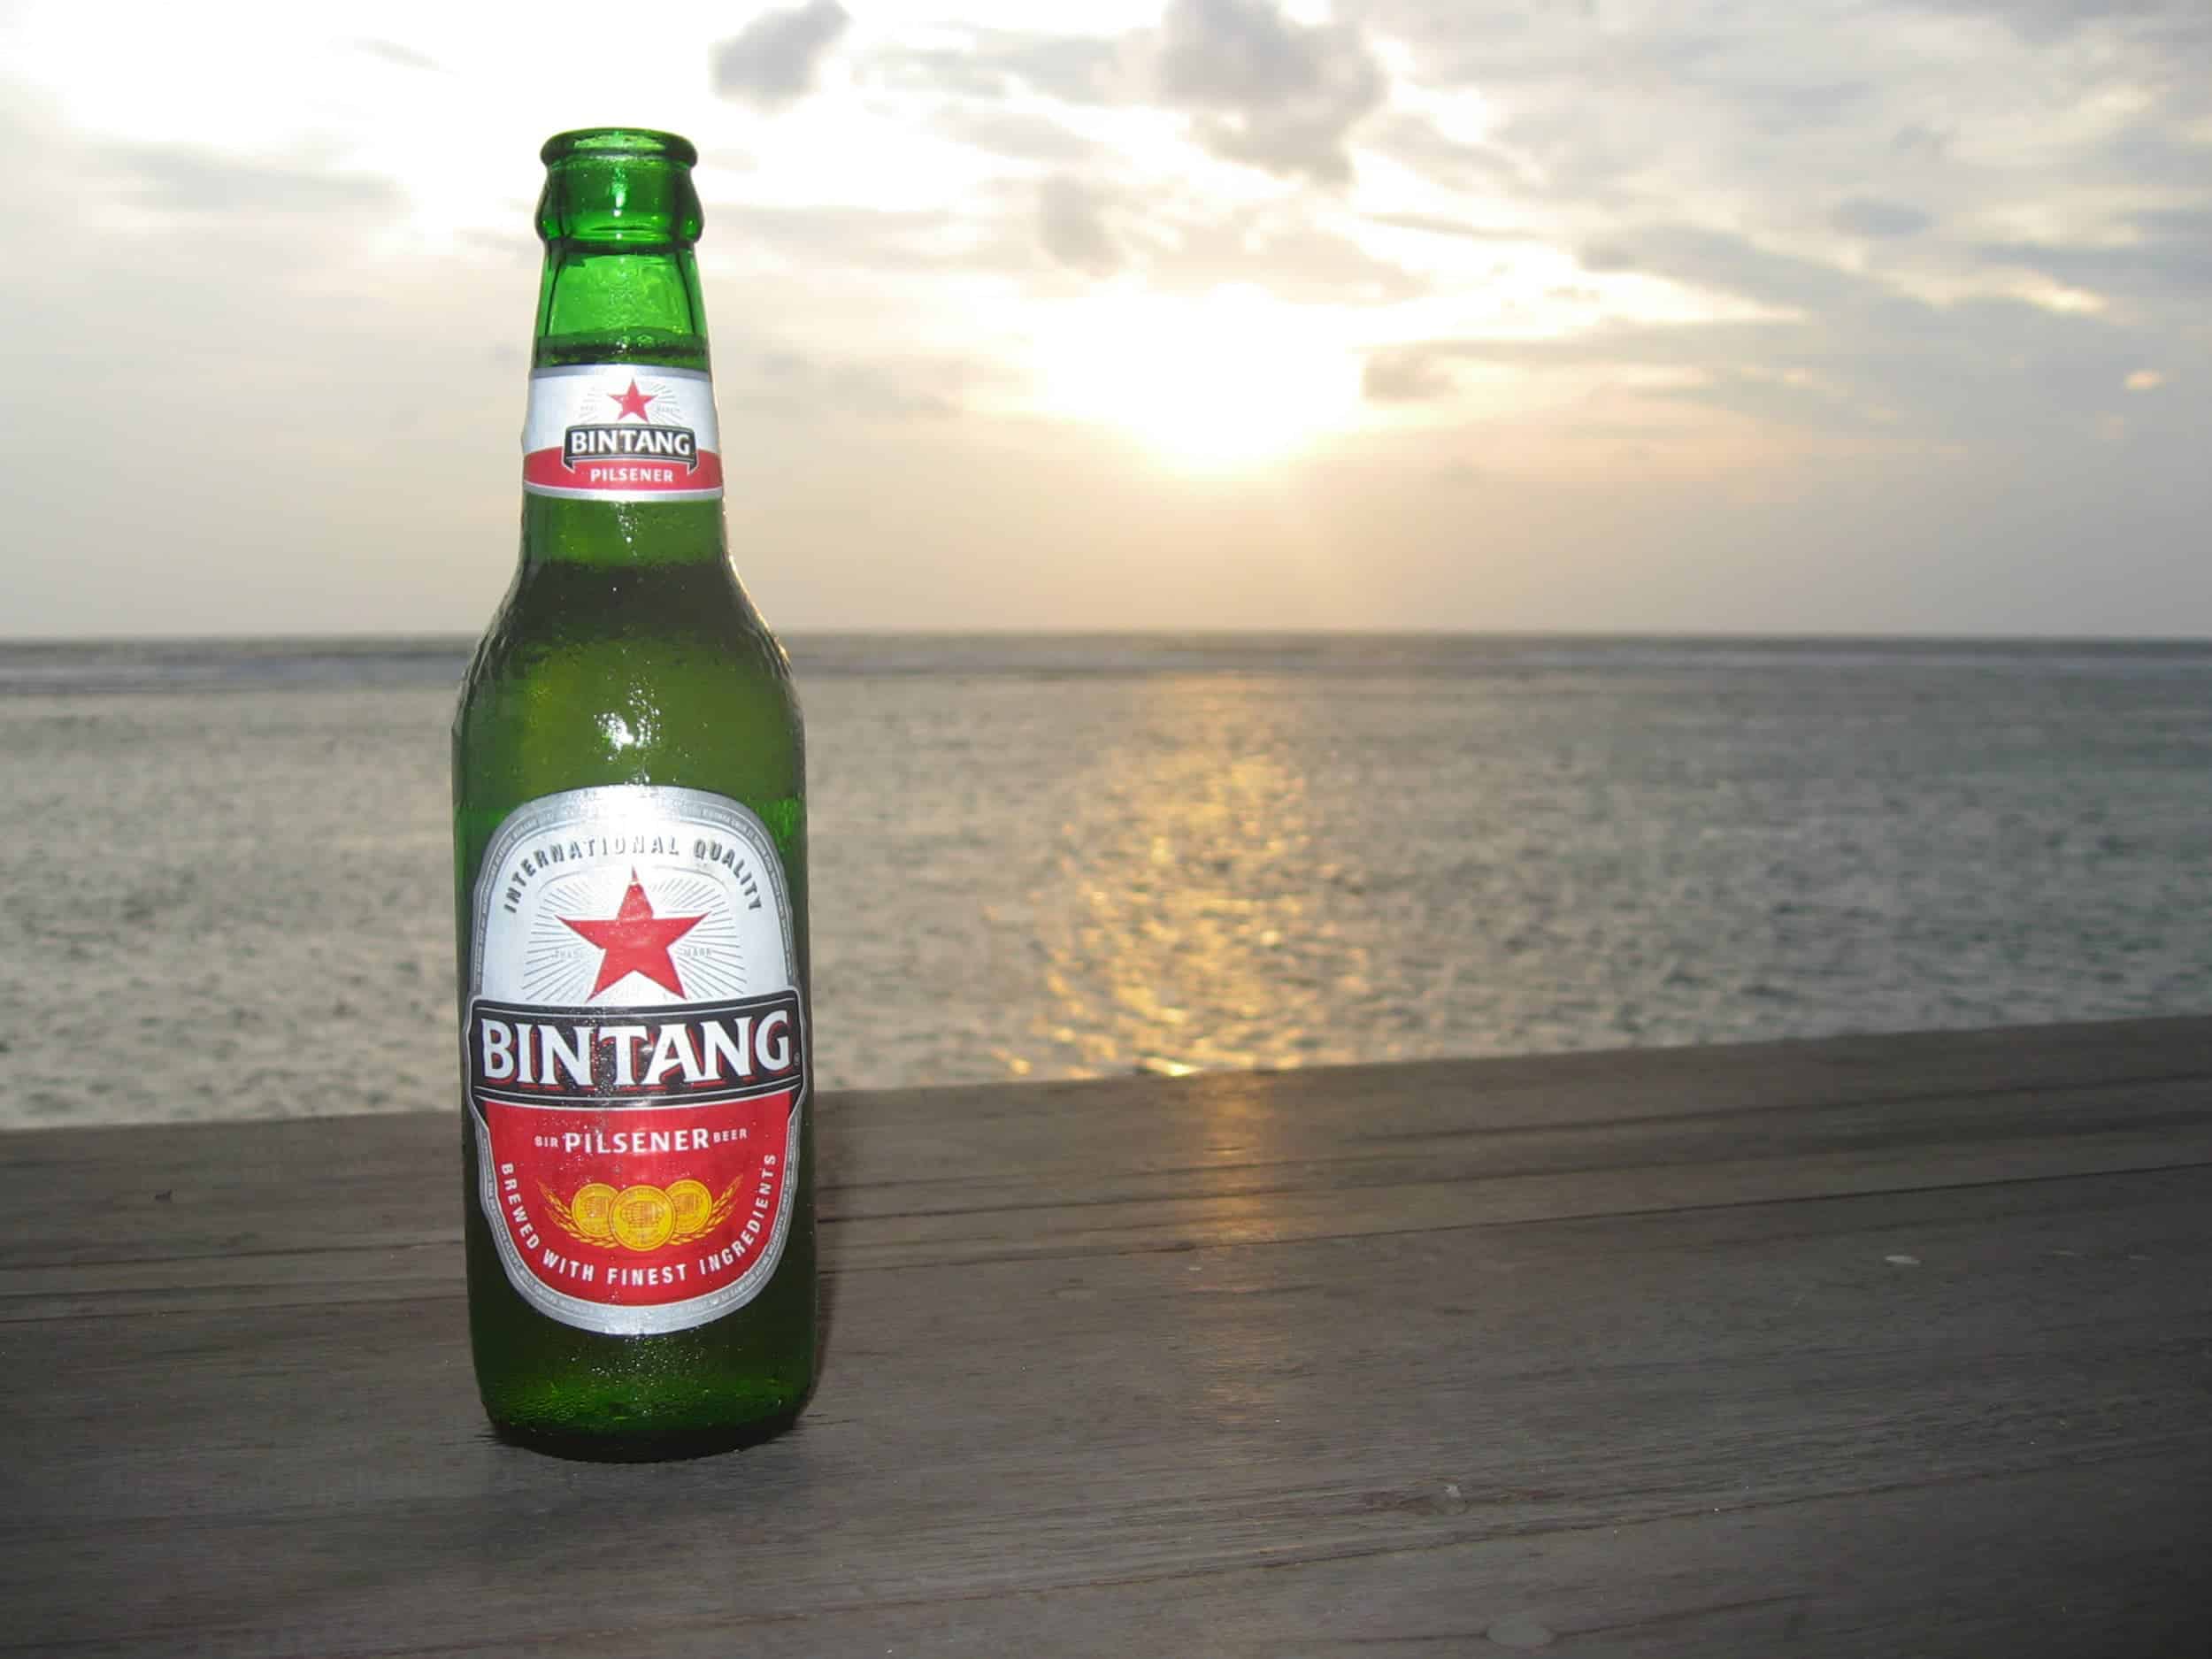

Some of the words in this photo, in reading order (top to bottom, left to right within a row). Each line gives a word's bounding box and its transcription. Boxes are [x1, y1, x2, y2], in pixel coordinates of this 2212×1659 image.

[570, 429, 690, 456] BINTANG
[589, 467, 673, 482] PILSENER
[503, 835, 680, 913] INTERNATIONAL
[693, 839, 764, 910] QUALITY
[481, 1010, 790, 1087] BINTANG
[534, 1135, 559, 1148] BIR
[565, 1128, 710, 1154] PILSENER
[713, 1128, 748, 1143] BEER
[501, 1163, 541, 1250] BREWED
[541, 1248, 595, 1281] WITH
[606, 1263, 687, 1286] FINEST
[699, 1153, 777, 1275] INGREDIENTS
